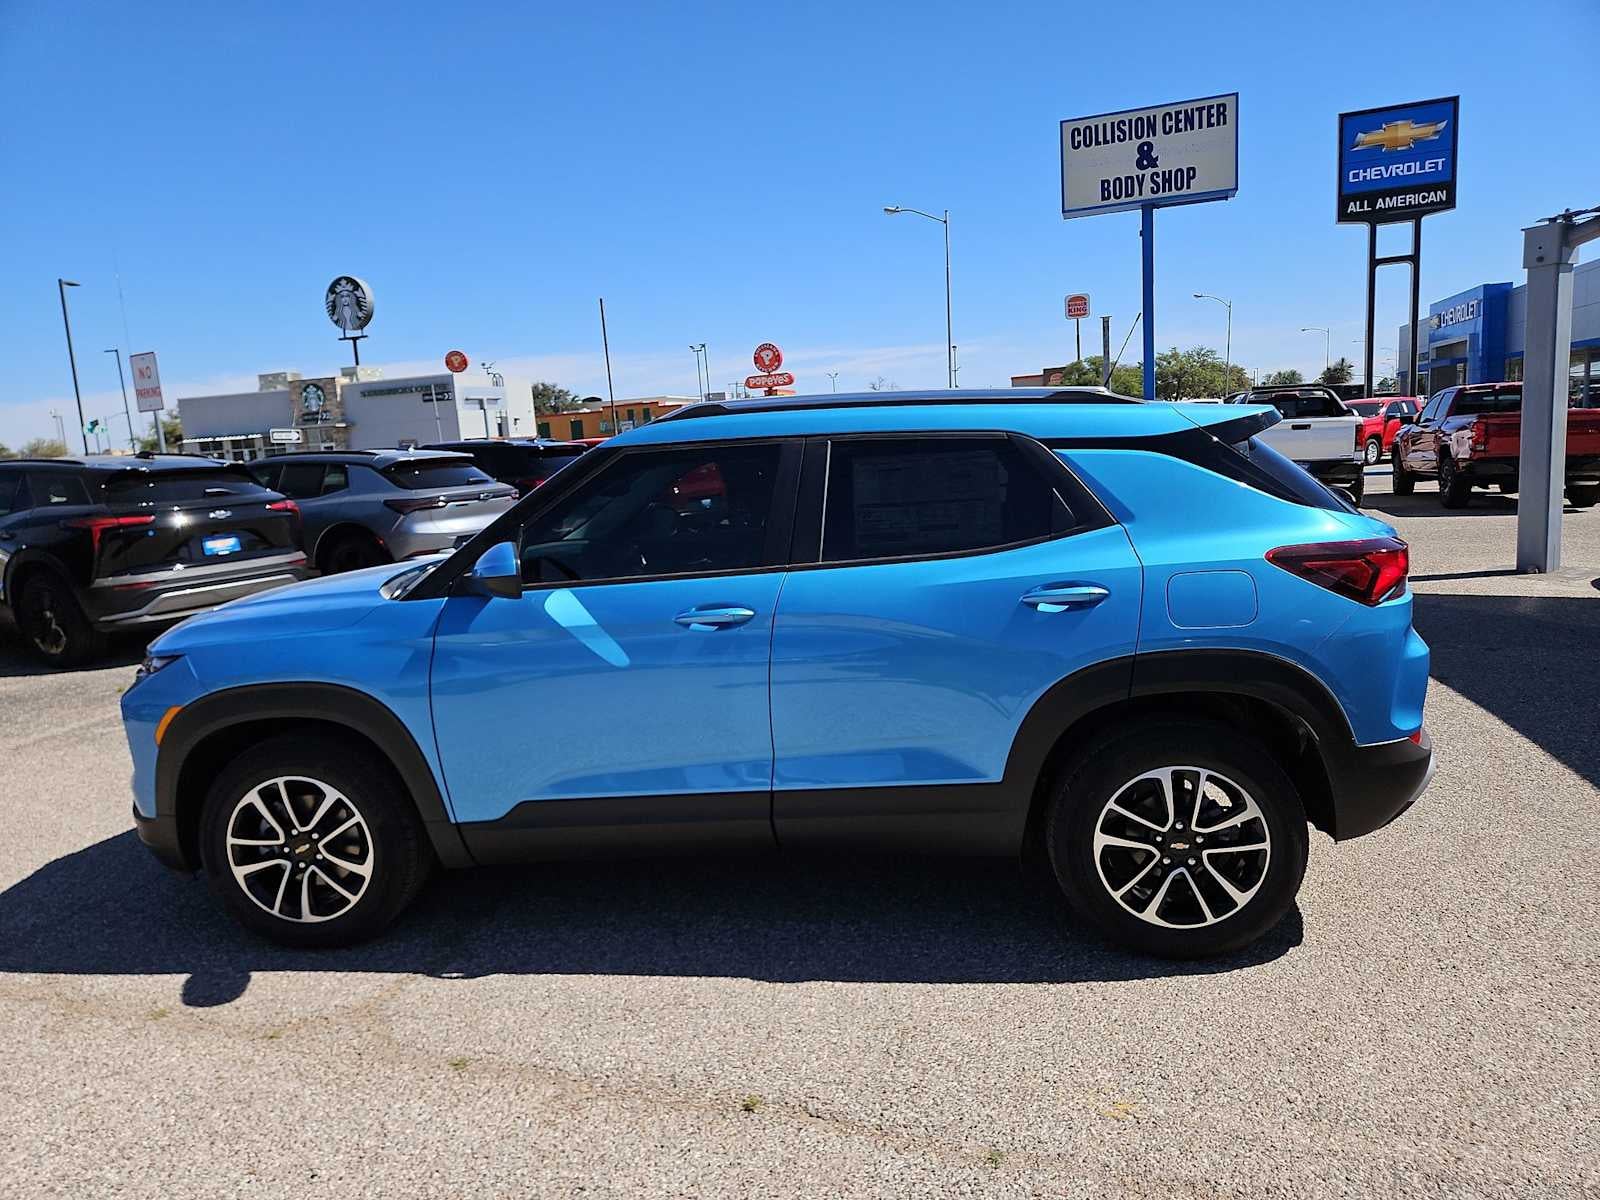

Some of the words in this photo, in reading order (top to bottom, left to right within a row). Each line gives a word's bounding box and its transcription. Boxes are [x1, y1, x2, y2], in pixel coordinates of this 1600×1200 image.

[1070, 115, 1157, 150] COLLISION
[1162, 102, 1228, 136] CENTER
[1135, 140, 1159, 171] &
[1348, 158, 1446, 183] CHEVROLET
[1100, 174, 1146, 202] BODY
[1149, 166, 1197, 195] SHOP
[1347, 200, 1373, 214] ALL
[1375, 189, 1447, 210] AMERICAN
[1067, 306, 1088, 314] KING
[1440, 299, 1479, 328] CHEVROLET
[138, 366, 152, 379] NO
[136, 386, 161, 399] PARKING
